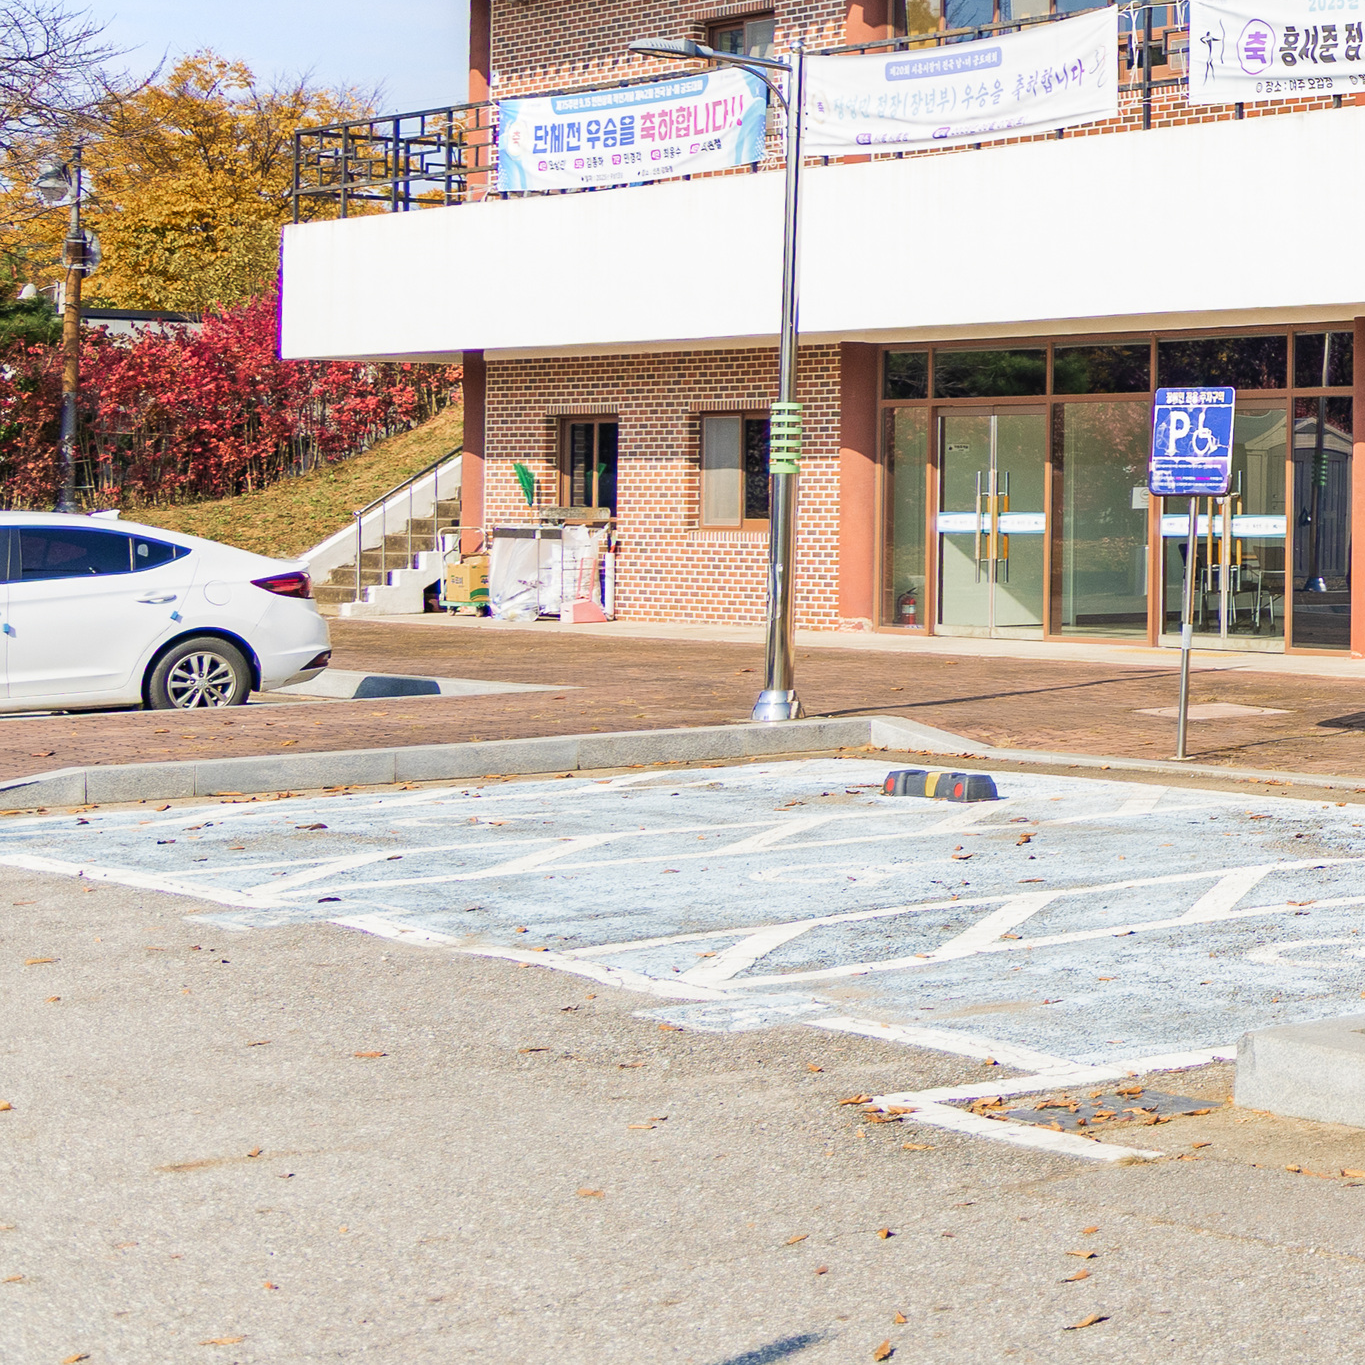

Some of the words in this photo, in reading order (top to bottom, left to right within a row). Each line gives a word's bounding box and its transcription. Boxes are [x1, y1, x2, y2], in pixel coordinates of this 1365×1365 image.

[1244, 31, 1267, 64] 축
[1279, 24, 1339, 67] 홍서준
[961, 78, 1004, 110] 우승을
[1012, 58, 1085, 101] 축하합니다
[1265, 80, 1282, 93] 장소
[1289, 78, 1306, 91] 여주
[533, 122, 580, 154] 단체전
[586, 115, 635, 150] 우승을
[640, 94, 744, 142] 축하합니다!!
[1168, 410, 1191, 457] P
